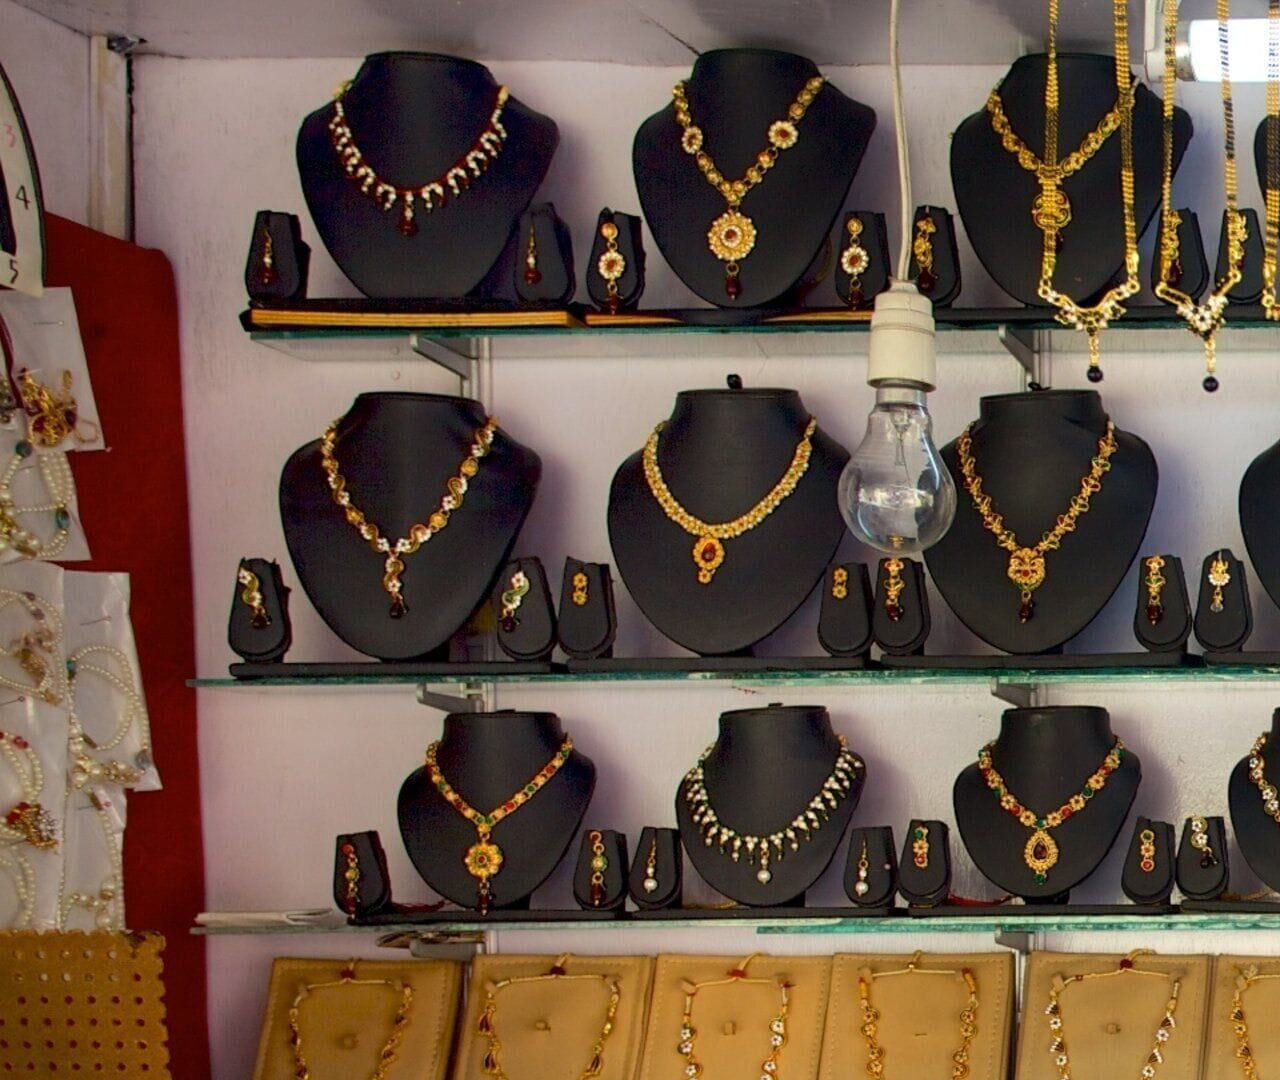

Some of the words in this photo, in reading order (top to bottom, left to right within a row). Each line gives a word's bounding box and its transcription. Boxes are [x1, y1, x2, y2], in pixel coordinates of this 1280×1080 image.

[4, 123, 17, 148] 3
[15, 184, 31, 210] 4
[9, 258, 19, 284] 5
